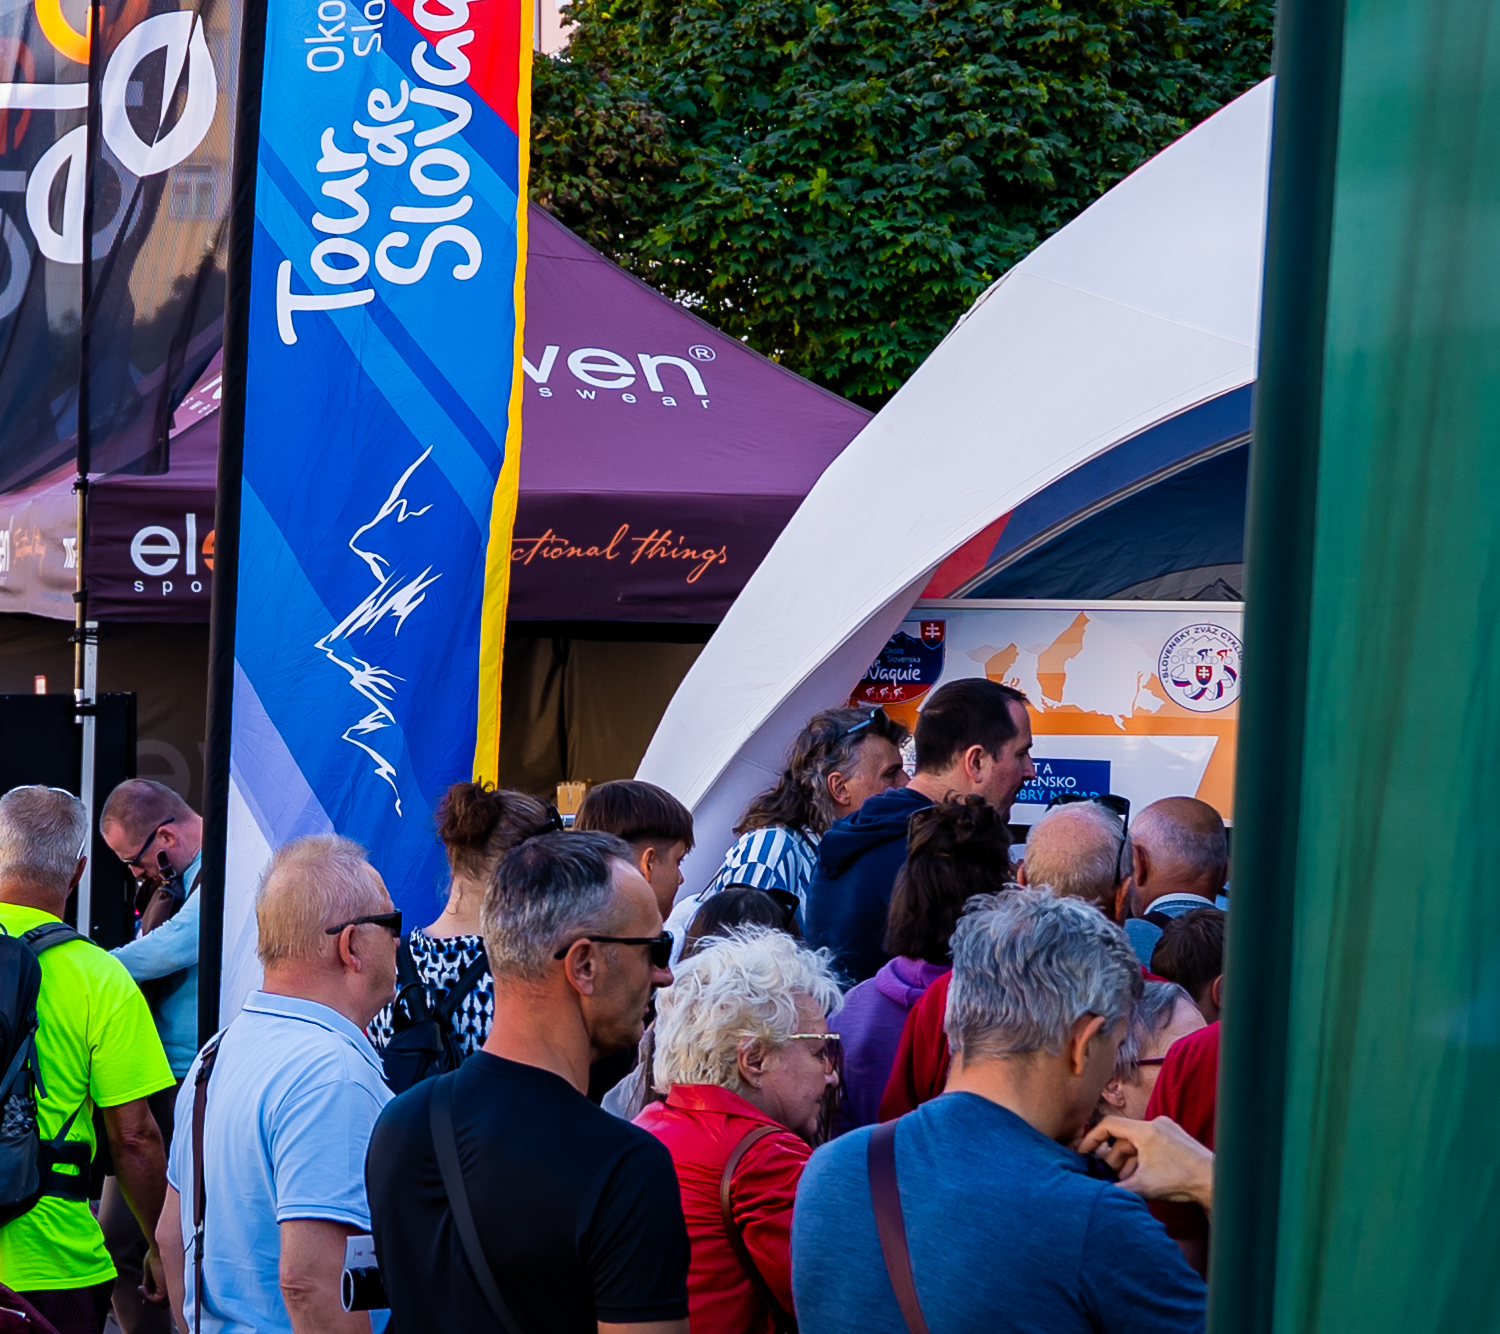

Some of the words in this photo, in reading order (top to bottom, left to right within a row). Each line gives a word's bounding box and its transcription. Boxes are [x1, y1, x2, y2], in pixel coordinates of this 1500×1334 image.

[353, 79, 415, 166] de
[277, 126, 376, 345] Tour
[522, 345, 708, 396] ven
[538, 386, 710, 409] swear
[511, 523, 629, 565] ctional
[630, 528, 728, 584] things
[1162, 628, 1191, 679] SLOVENSKÝ
[1024, 775, 1076, 788] VENSKO
